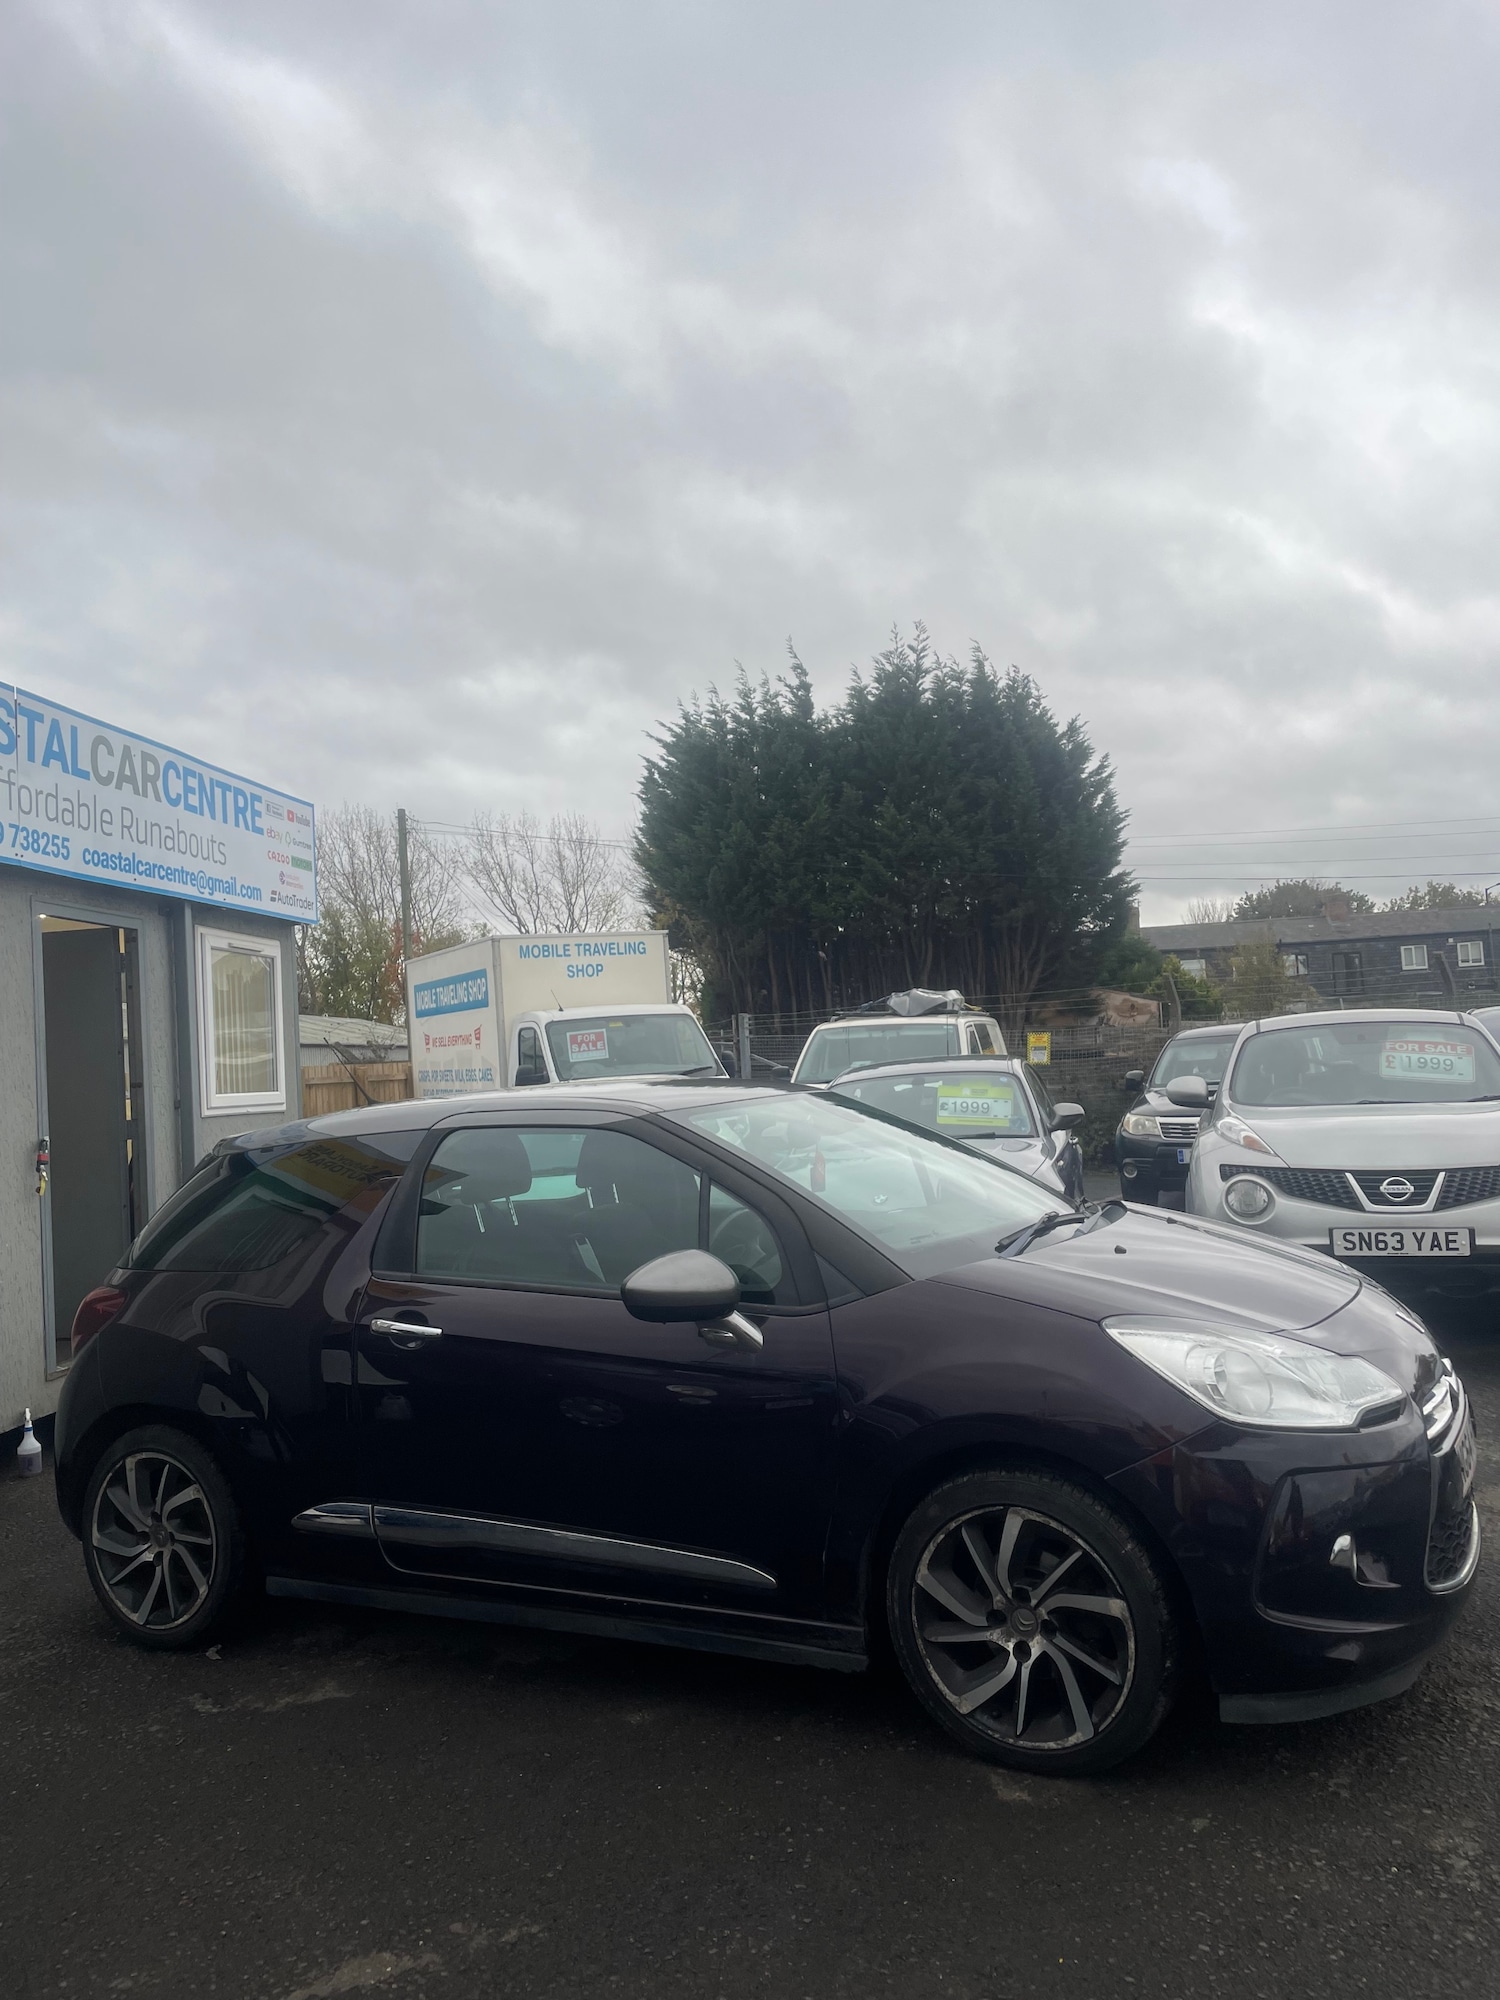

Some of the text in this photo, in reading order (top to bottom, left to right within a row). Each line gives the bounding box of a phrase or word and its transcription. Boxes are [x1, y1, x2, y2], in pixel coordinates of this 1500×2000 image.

[121, 806, 227, 866] Runabouts
[8, 822, 71, 861] 738255
[82, 848, 263, 902] coastalcarcentre@gmail.com
[277, 891, 314, 911] AutoTrader
[519, 941, 647, 959] MOBILE TRAVELING
[566, 963, 604, 978] SHOP
[416, 978, 487, 1010] MOBILE TRAVELING SHOP
[432, 1033, 472, 1048] WE SELL EVERYTHING
[571, 1041, 605, 1052] SALE
[577, 1033, 596, 1043] FOR
[1385, 1042, 1467, 1054] FOR SALE
[465, 1068, 478, 1084] EGGS,
[478, 1067, 494, 1084] CAKES,
[939, 1100, 990, 1114] £1999
[1342, 1231, 1460, 1252] SN63 YAE
